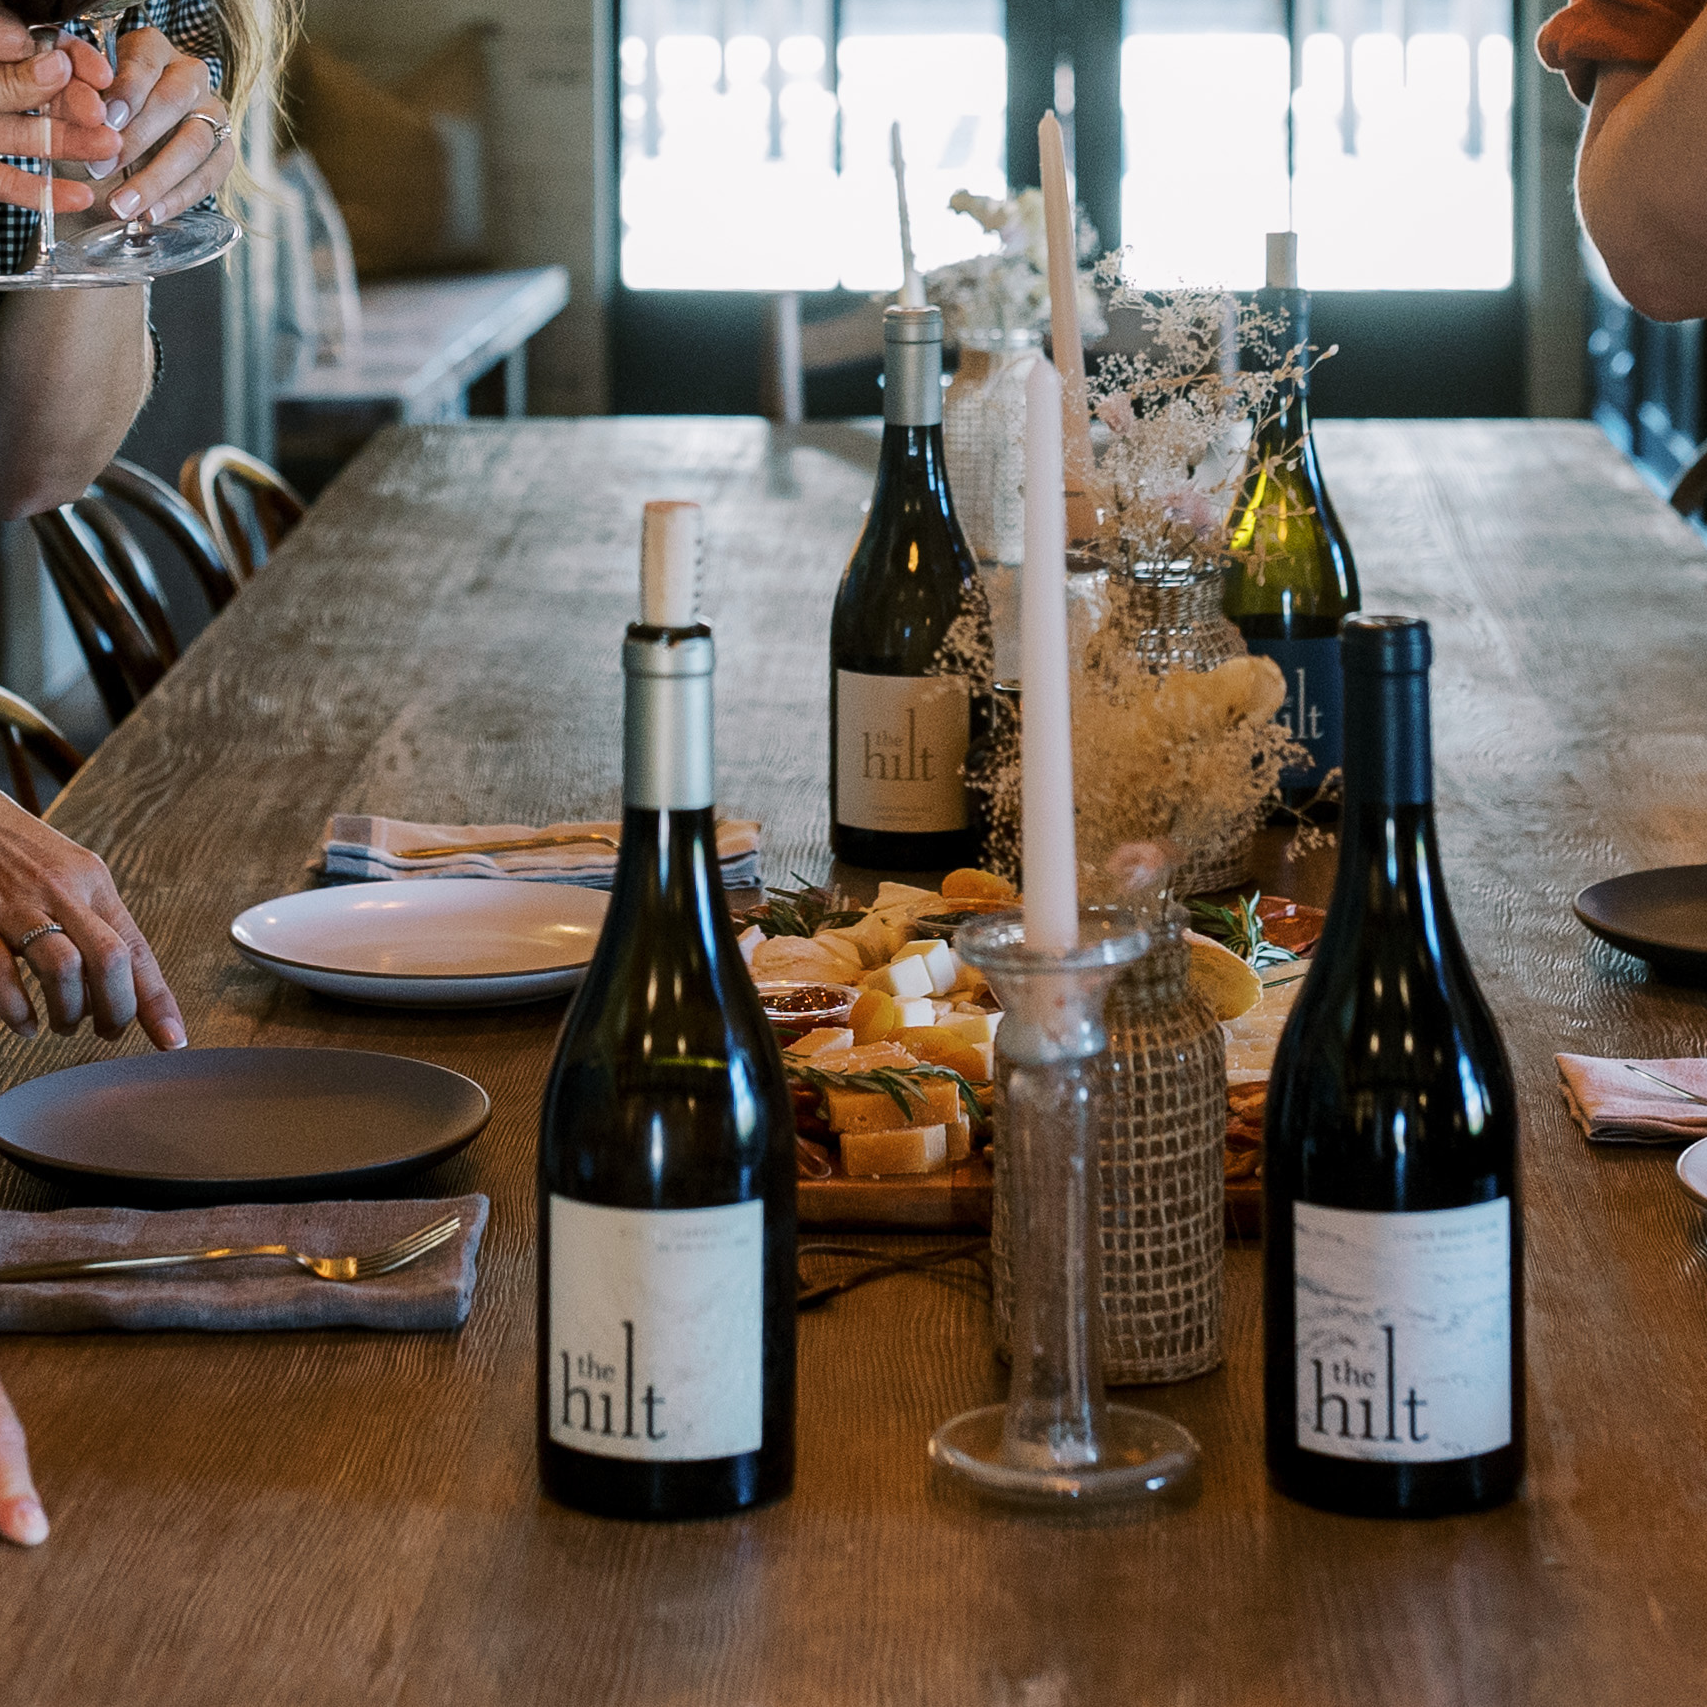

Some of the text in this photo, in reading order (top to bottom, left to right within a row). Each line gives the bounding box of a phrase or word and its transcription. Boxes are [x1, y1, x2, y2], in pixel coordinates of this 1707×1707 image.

[862, 707, 938, 782] hilt
[560, 1319, 668, 1442] hilt
[577, 1352, 617, 1383] the
[1311, 1324, 1429, 1443] hilt
[1332, 1357, 1376, 1389] the
